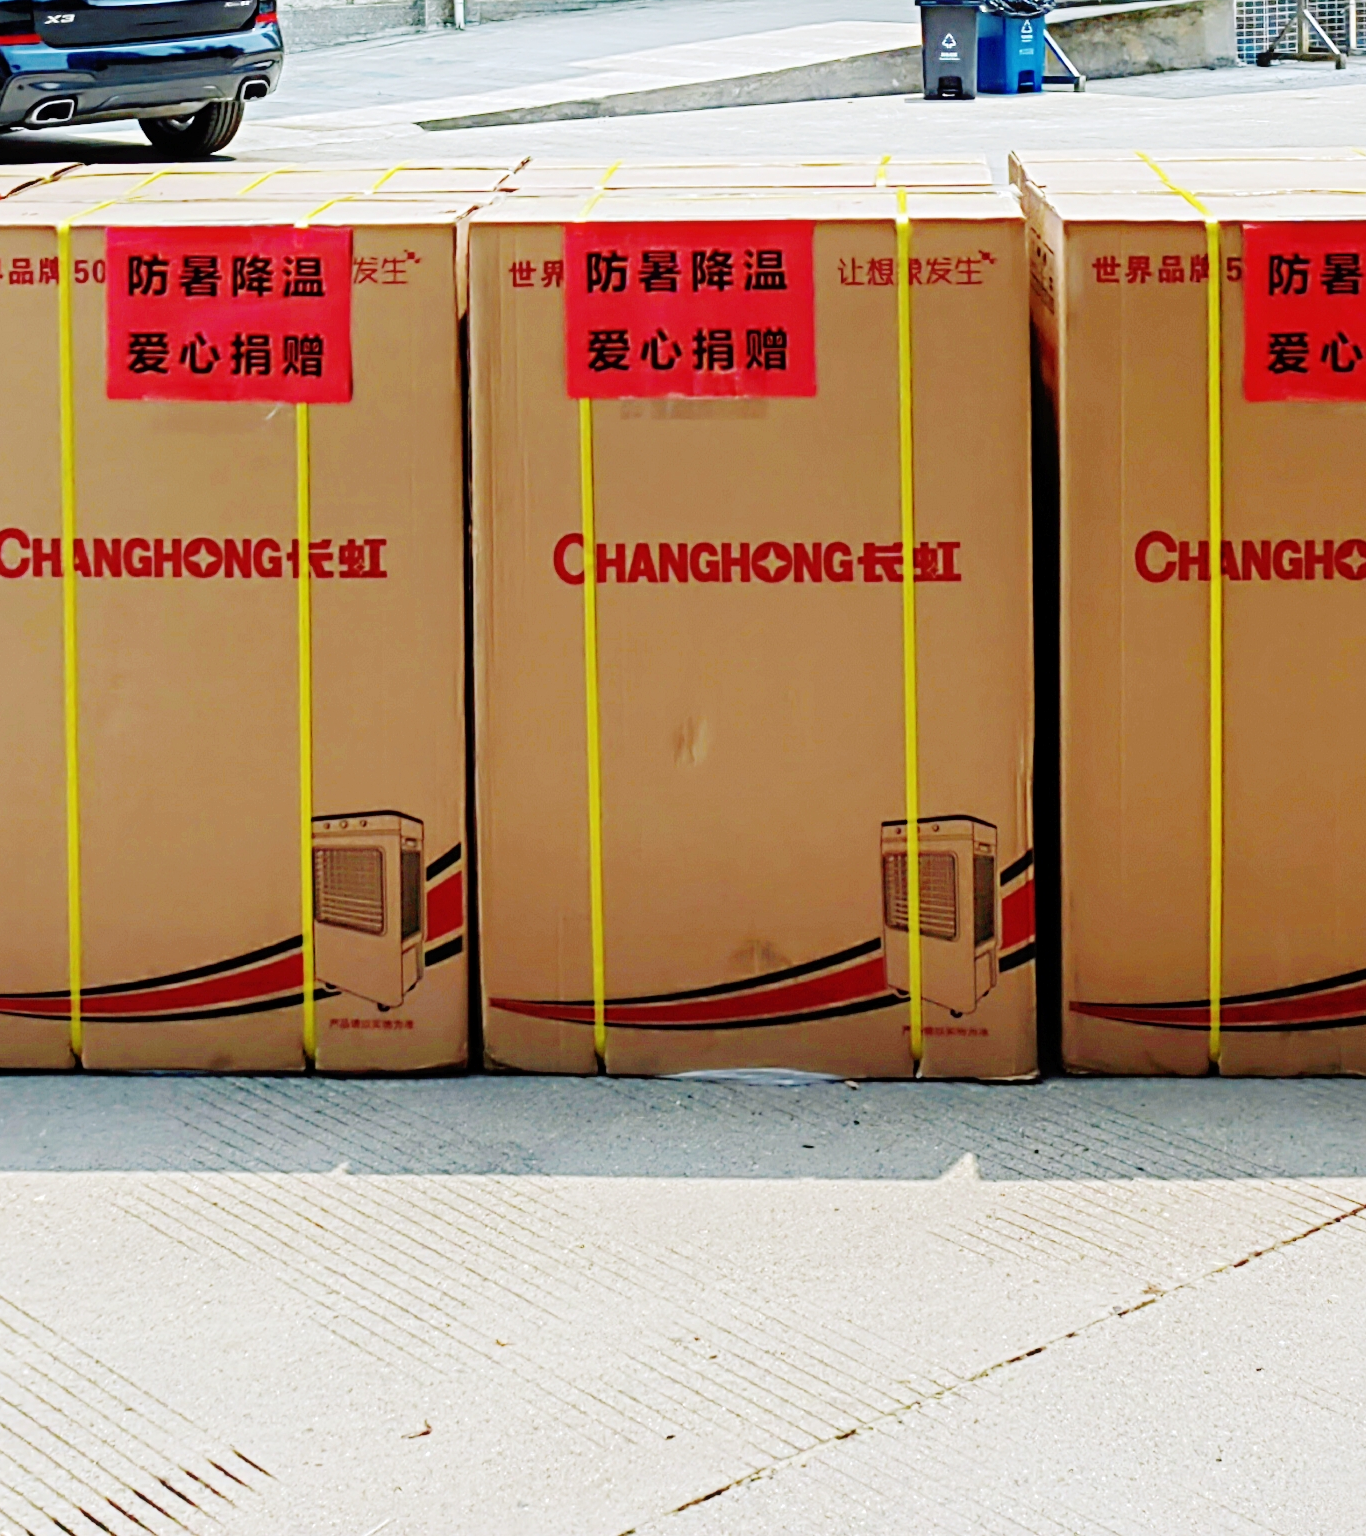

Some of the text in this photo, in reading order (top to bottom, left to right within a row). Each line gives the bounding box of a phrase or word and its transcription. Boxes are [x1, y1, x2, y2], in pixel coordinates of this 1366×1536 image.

[45, 14, 75, 25] X3
[128, 255, 326, 298] 防暑降温
[586, 250, 788, 293] 防暑降温
[128, 332, 325, 377] 爱心捐赠
[586, 329, 788, 372] 爱心捐赠
